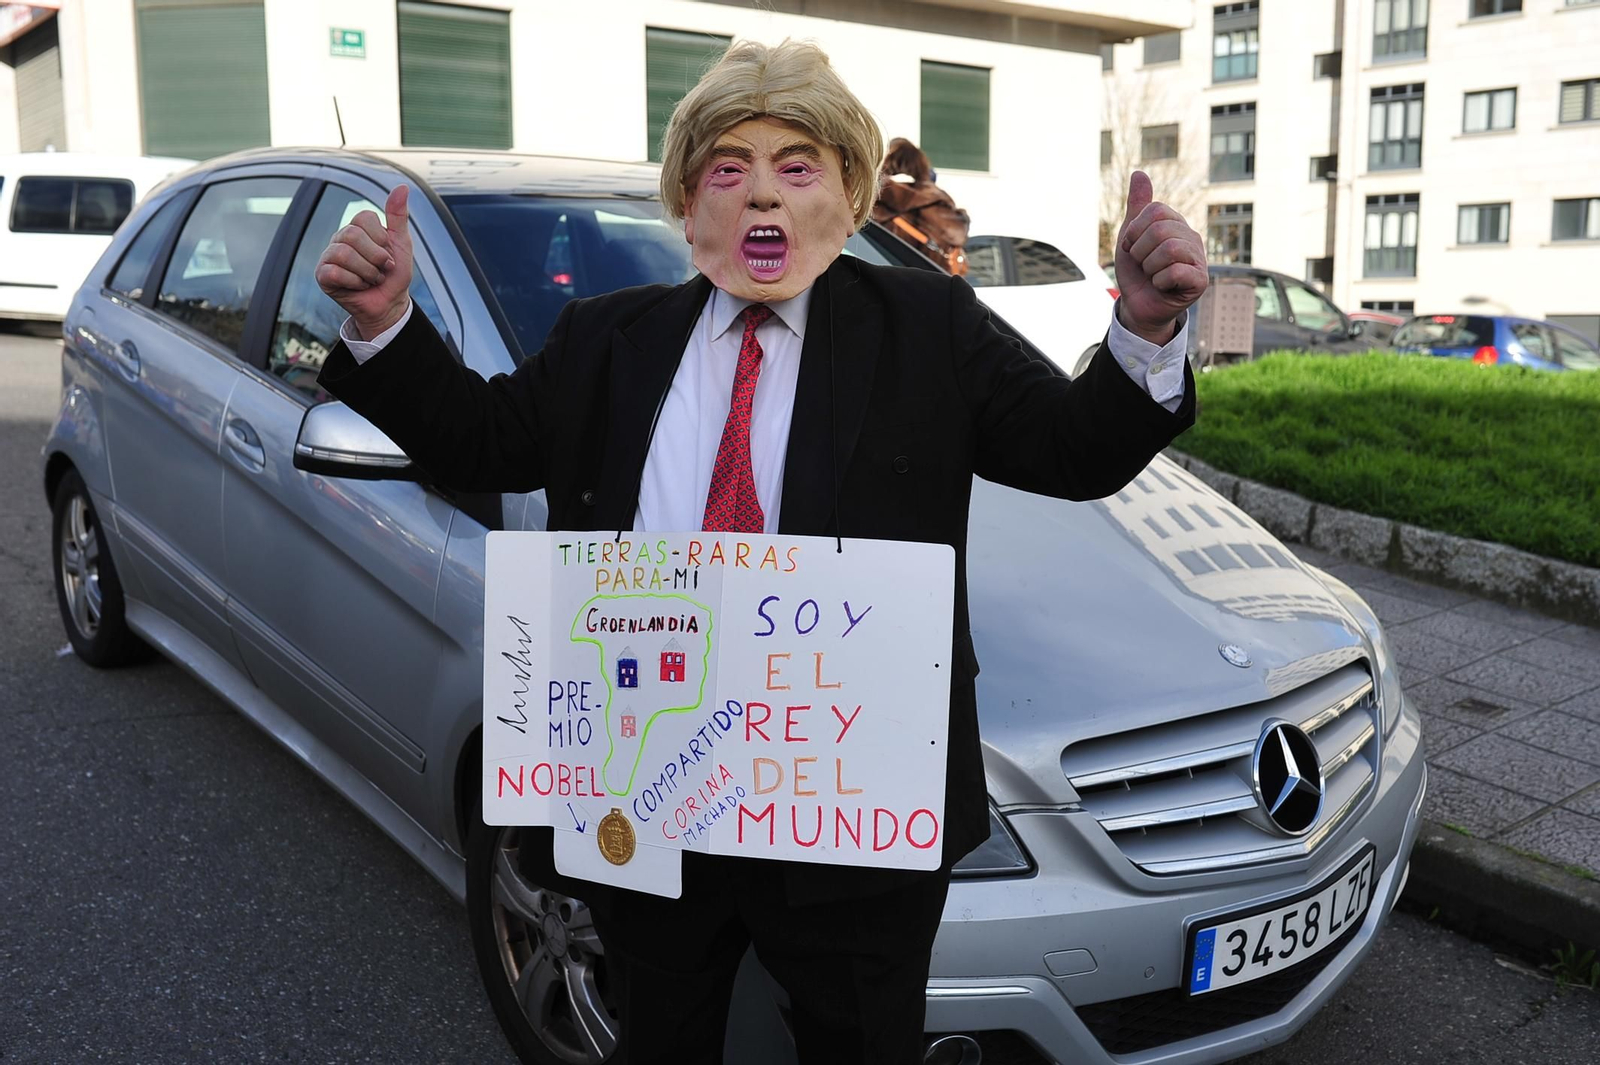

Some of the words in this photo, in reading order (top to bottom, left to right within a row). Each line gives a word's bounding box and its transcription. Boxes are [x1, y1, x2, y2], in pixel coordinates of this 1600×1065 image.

[754, 595, 873, 638] SOY
[766, 652, 842, 691] EL
[549, 681, 601, 715] PRE-
[745, 702, 862, 744] REY
[498, 762, 605, 798] NOBEL
[752, 756, 863, 796] DEL
[662, 764, 734, 840] CORINA
[683, 786, 746, 846] MACHADO
[737, 803, 939, 852] MUNDO
[1222, 901, 1321, 977] 3458
[1329, 860, 1371, 936] LZF
[1196, 967, 1206, 982] E
